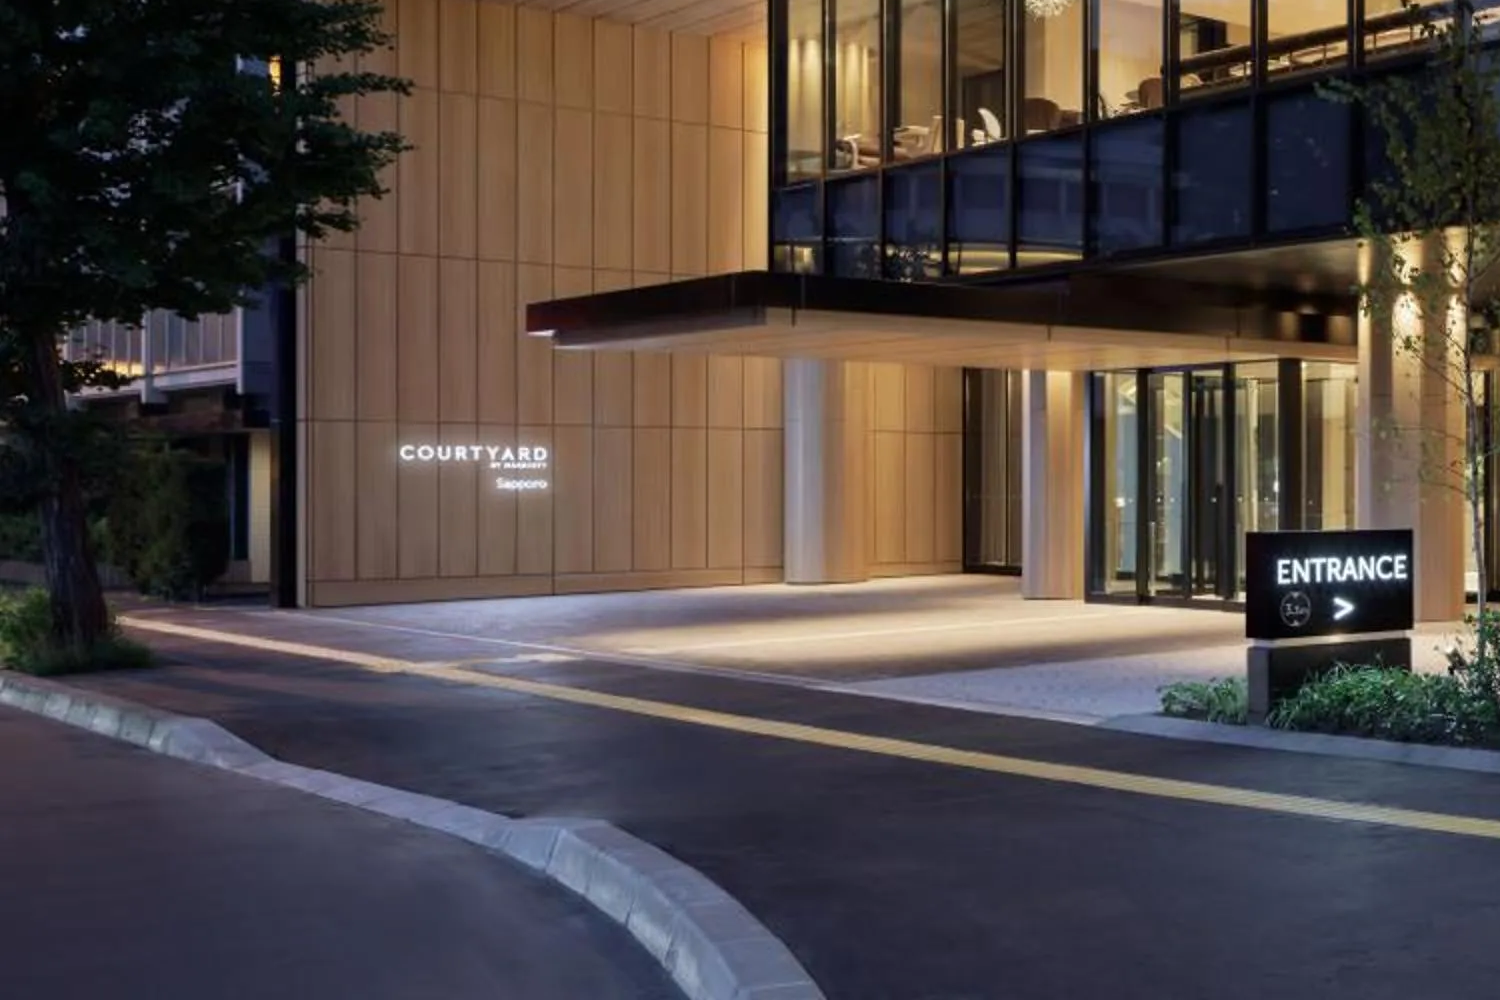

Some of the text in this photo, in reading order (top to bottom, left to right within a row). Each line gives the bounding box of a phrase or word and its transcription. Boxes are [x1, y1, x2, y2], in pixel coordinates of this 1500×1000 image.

[399, 444, 548, 461] COURTYARD
[496, 477, 549, 491] Sapporo
[1276, 554, 1409, 585] ENTRANCE
